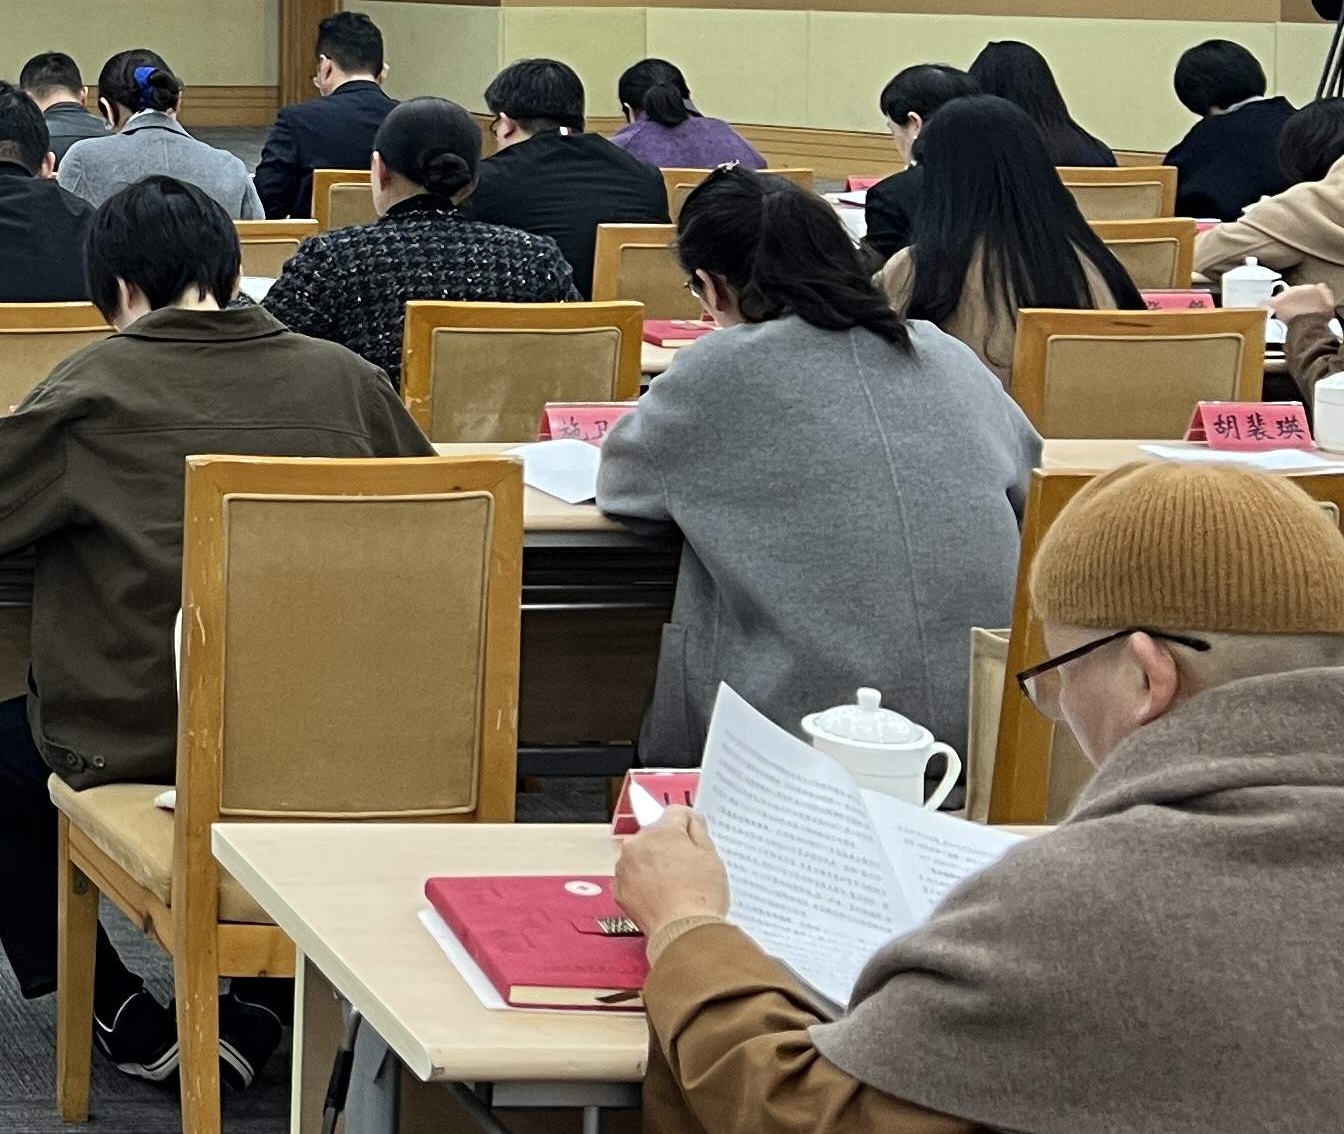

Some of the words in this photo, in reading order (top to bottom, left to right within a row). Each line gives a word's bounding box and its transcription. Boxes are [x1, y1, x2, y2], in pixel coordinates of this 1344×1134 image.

[559, 415, 609, 441] 施卫
[1212, 411, 1305, 441] 胡裴瑛
